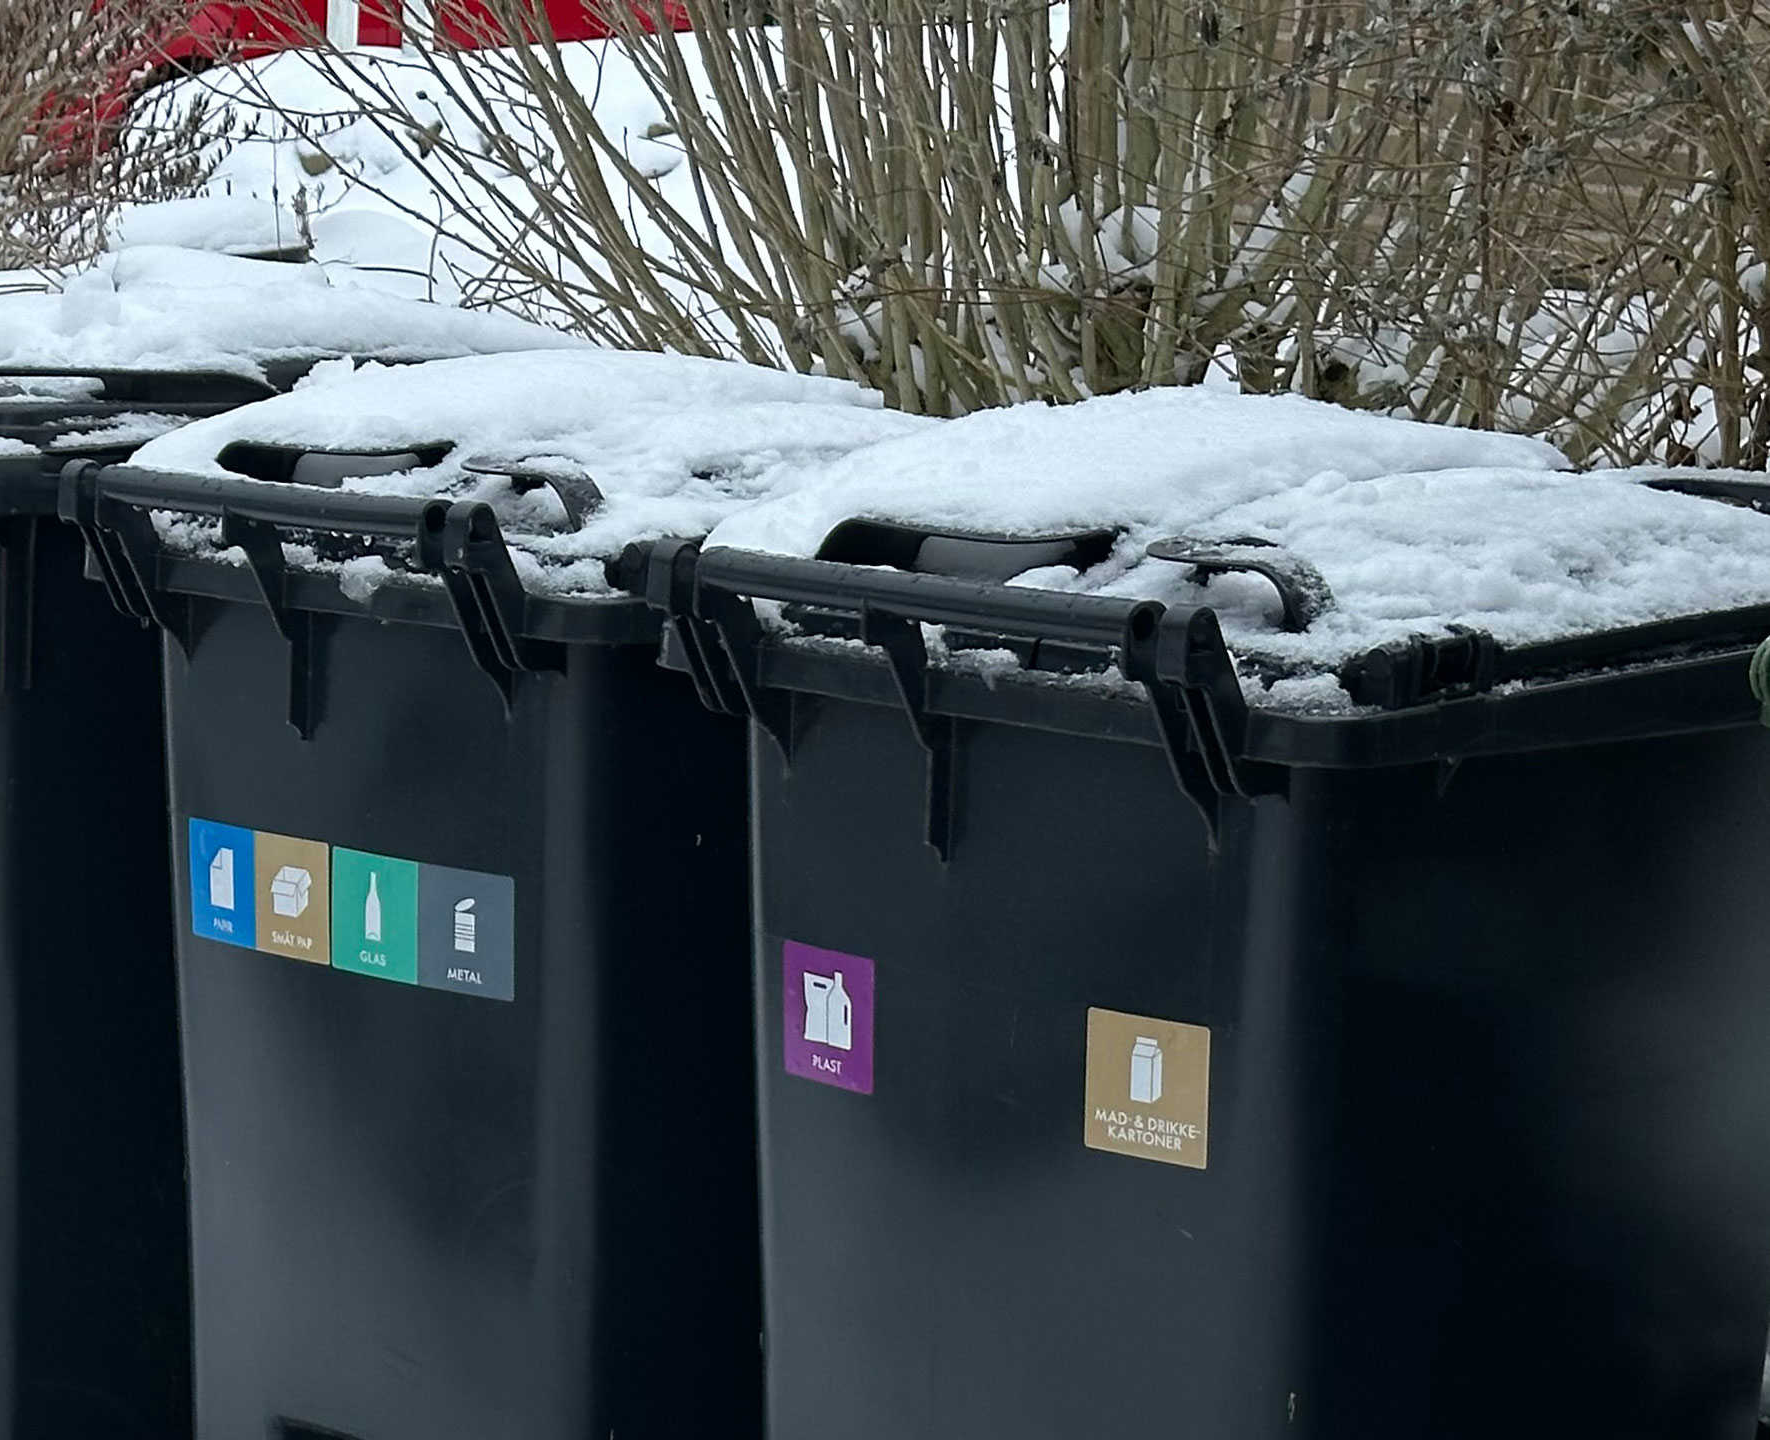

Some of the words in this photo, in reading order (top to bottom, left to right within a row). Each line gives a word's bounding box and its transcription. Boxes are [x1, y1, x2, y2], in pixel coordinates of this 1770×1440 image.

[359, 949, 386, 967] GLAS
[447, 967, 482, 985] METAL
[812, 1054, 842, 1075] PLAST
[1134, 1115, 1144, 1129] &
[1107, 1125, 1182, 1150] KARTONER
